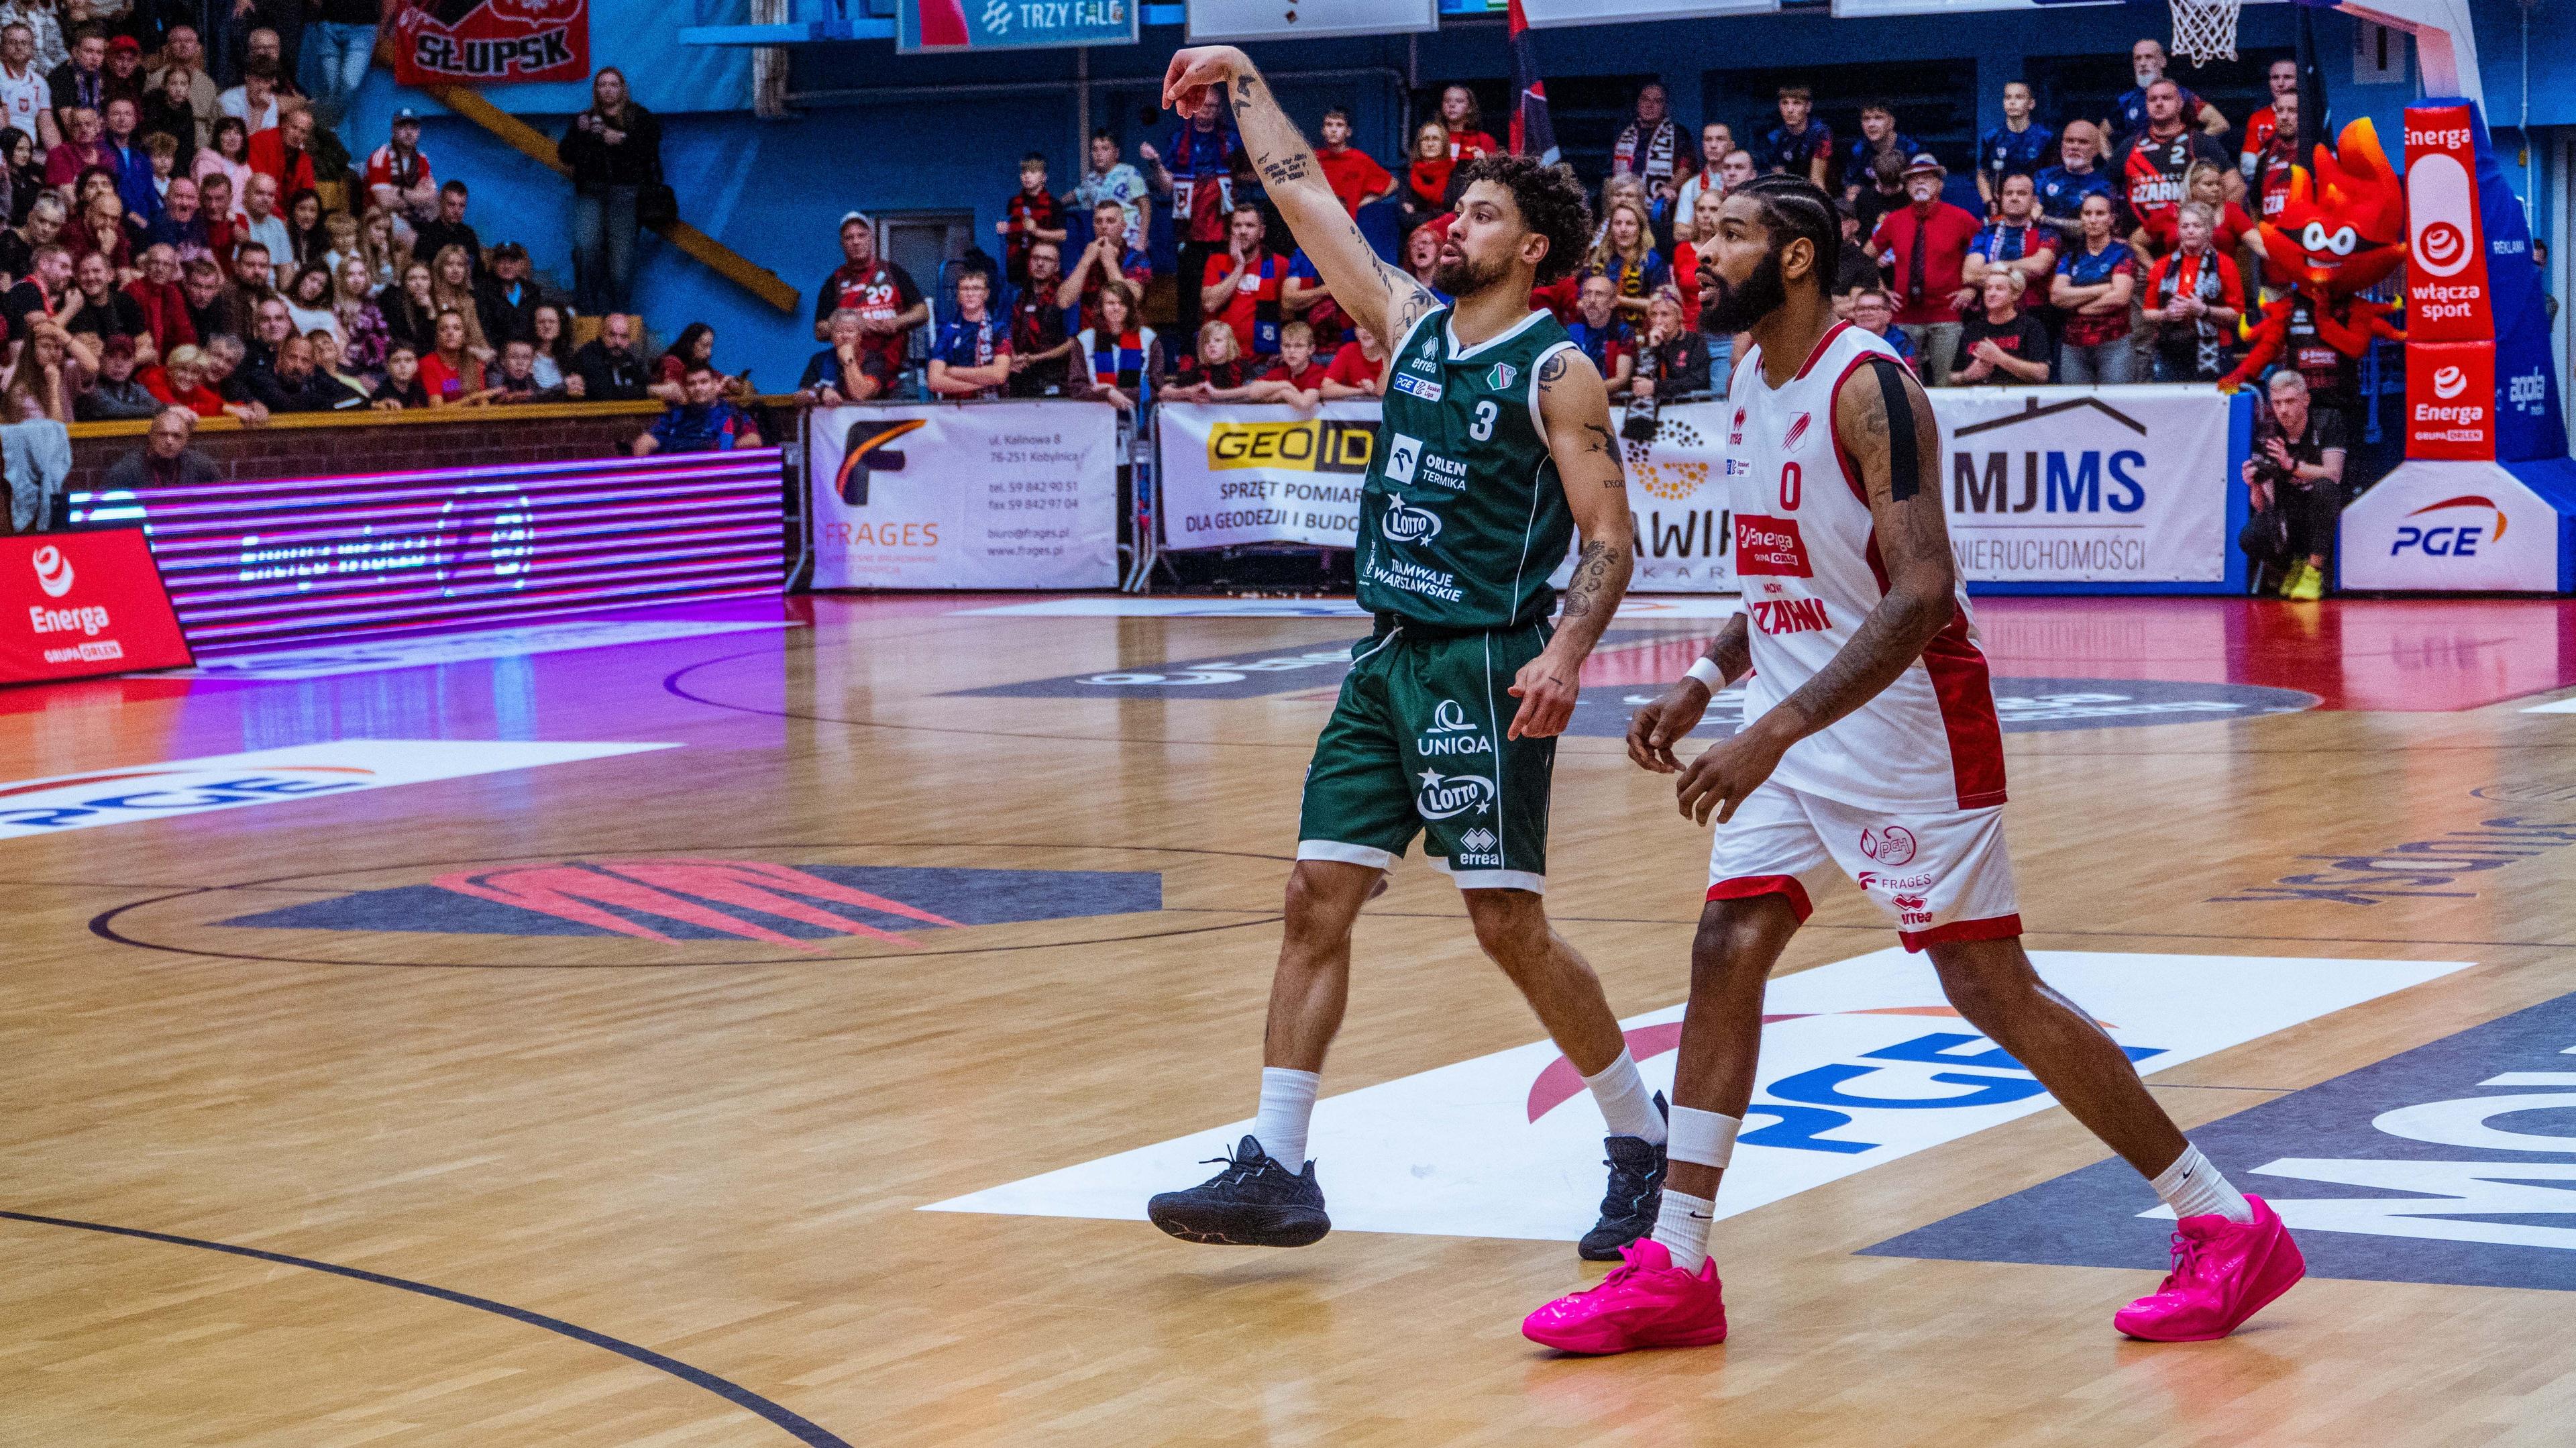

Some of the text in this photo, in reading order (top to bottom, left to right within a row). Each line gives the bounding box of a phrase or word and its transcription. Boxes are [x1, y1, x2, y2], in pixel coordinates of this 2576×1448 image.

[1019, 3, 1070, 28] TRZY
[416, 28, 572, 74] SŁUPSK
[2170, 146, 2186, 164] 2
[865, 285, 893, 305] 29
[2412, 282, 2480, 303] włącza
[2422, 303, 2472, 322] sport
[1412, 358, 1437, 373] errea
[1396, 375, 1414, 389] PGE
[1426, 384, 1441, 394] Basket
[1425, 391, 1434, 399] Liga
[1470, 401, 1498, 442] 3
[2415, 403, 2483, 425] Energa
[1215, 427, 1374, 465] GEOID
[1426, 454, 1467, 476] ORLEN
[1220, 480, 1279, 501] SPRZĘT
[1423, 470, 1467, 491] TERMIKA
[1780, 461, 1802, 511] 0
[1953, 450, 2146, 513] MJMS
[1186, 514, 1212, 532] DLA
[1214, 508, 1287, 529] GEODEZJI
[1392, 512, 1427, 535] LOTTO
[826, 523, 939, 547] FRAGES
[2391, 527, 2483, 556] PGE
[1952, 535, 2146, 570] NIERUCHOMOŚCI
[1391, 558, 1454, 587] TRAMWAJE
[1374, 569, 1462, 603] WARSZAWSKIE
[29, 605, 110, 636] Energa
[1417, 735, 1493, 756] UNIQA
[1429, 782, 1478, 811] LOTTO
[1460, 853, 1500, 866] errea
[1882, 874, 1932, 889] FRAGES
